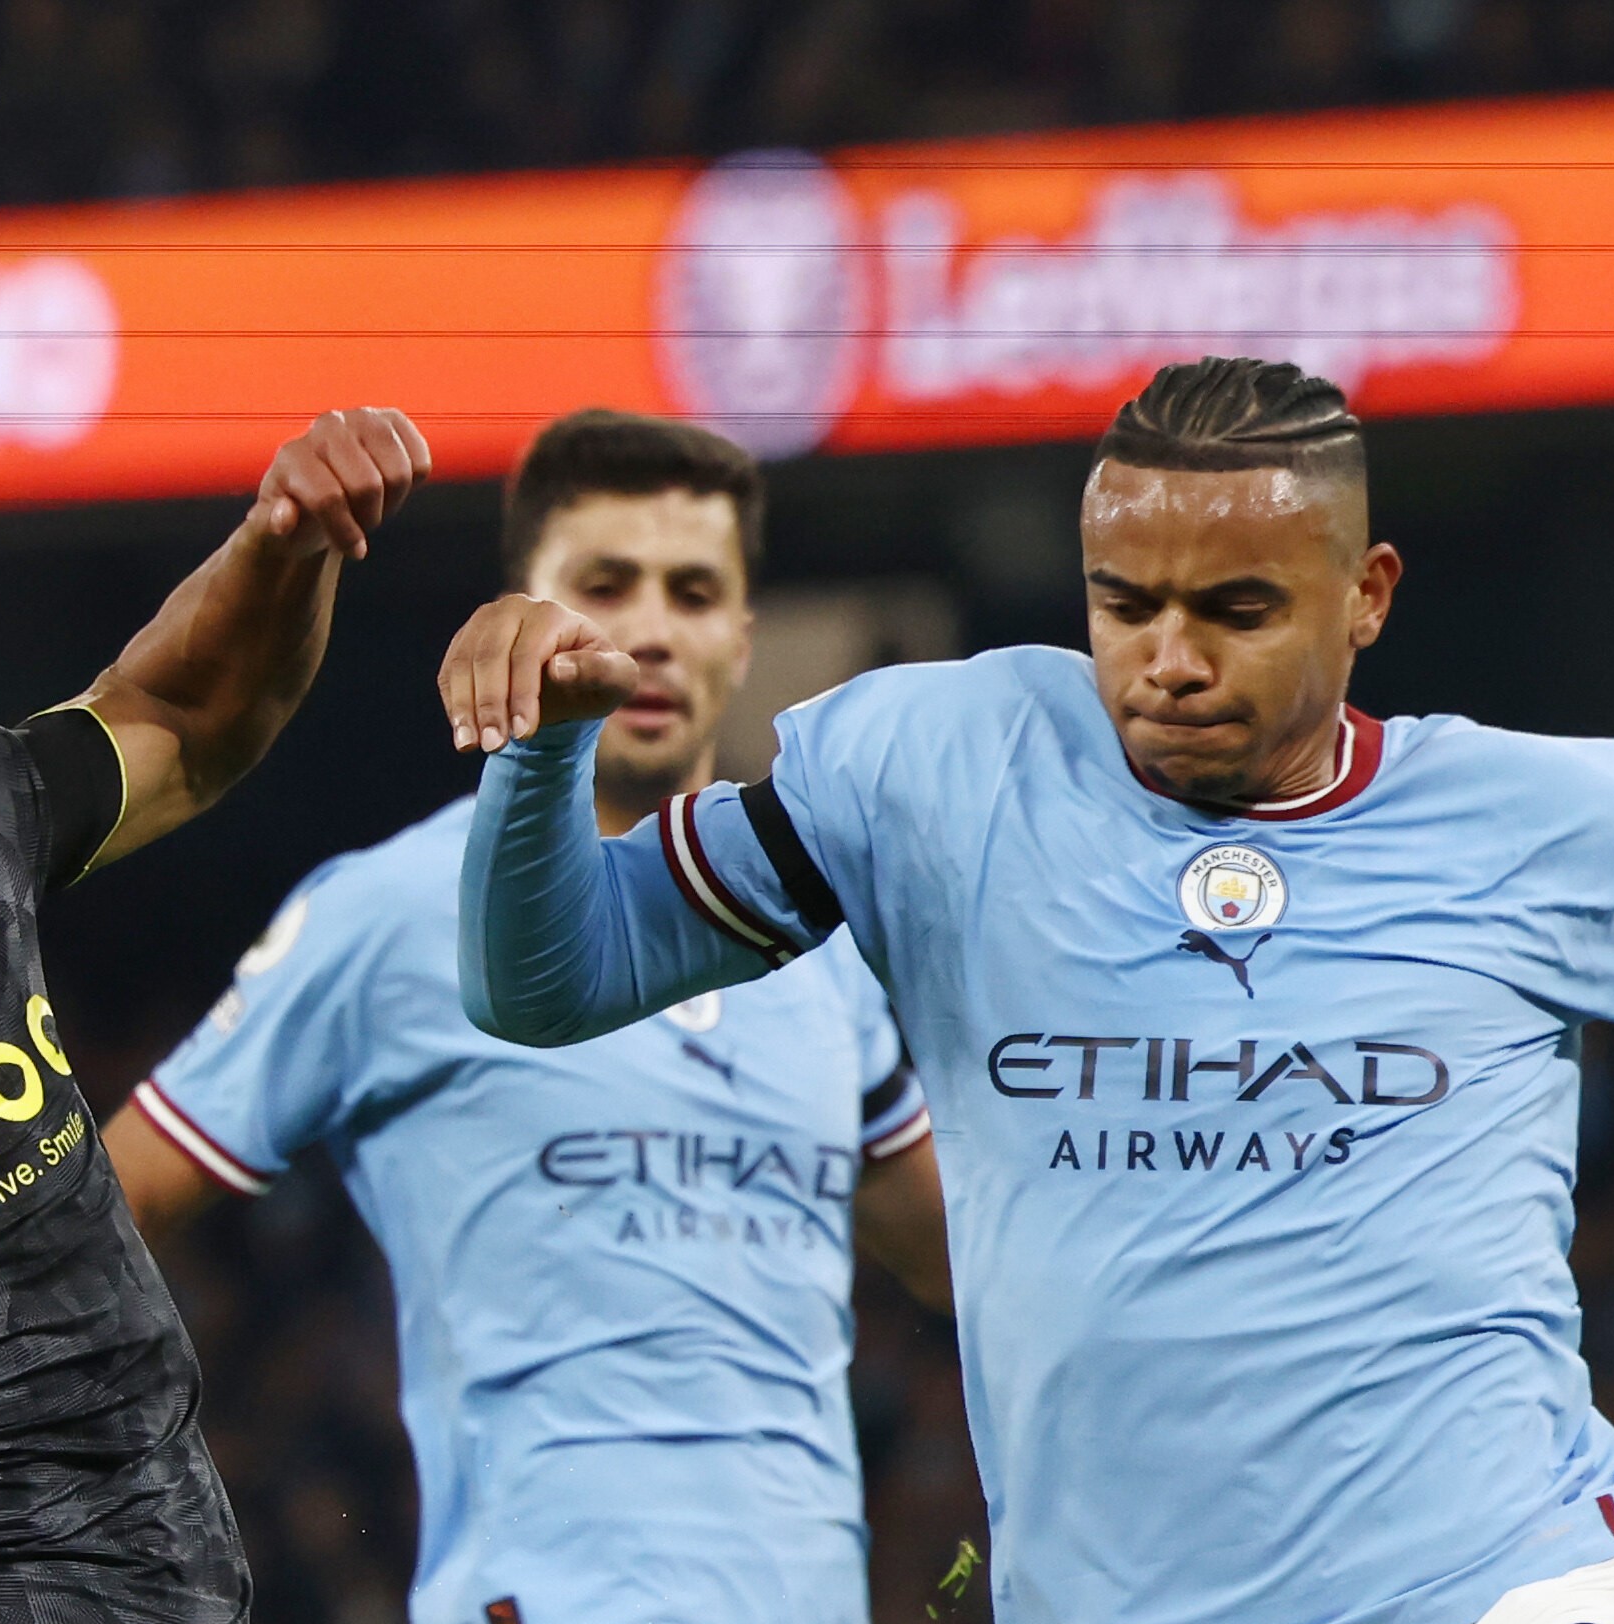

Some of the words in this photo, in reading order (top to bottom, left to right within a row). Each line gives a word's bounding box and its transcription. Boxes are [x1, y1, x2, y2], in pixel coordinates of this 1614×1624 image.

[1192, 850, 1278, 888] MANCHESTER
[988, 1032, 1449, 1106] ETIHAD
[538, 1130, 855, 1199] ETIHAD
[1049, 1127, 1354, 1171] AIRWAYS
